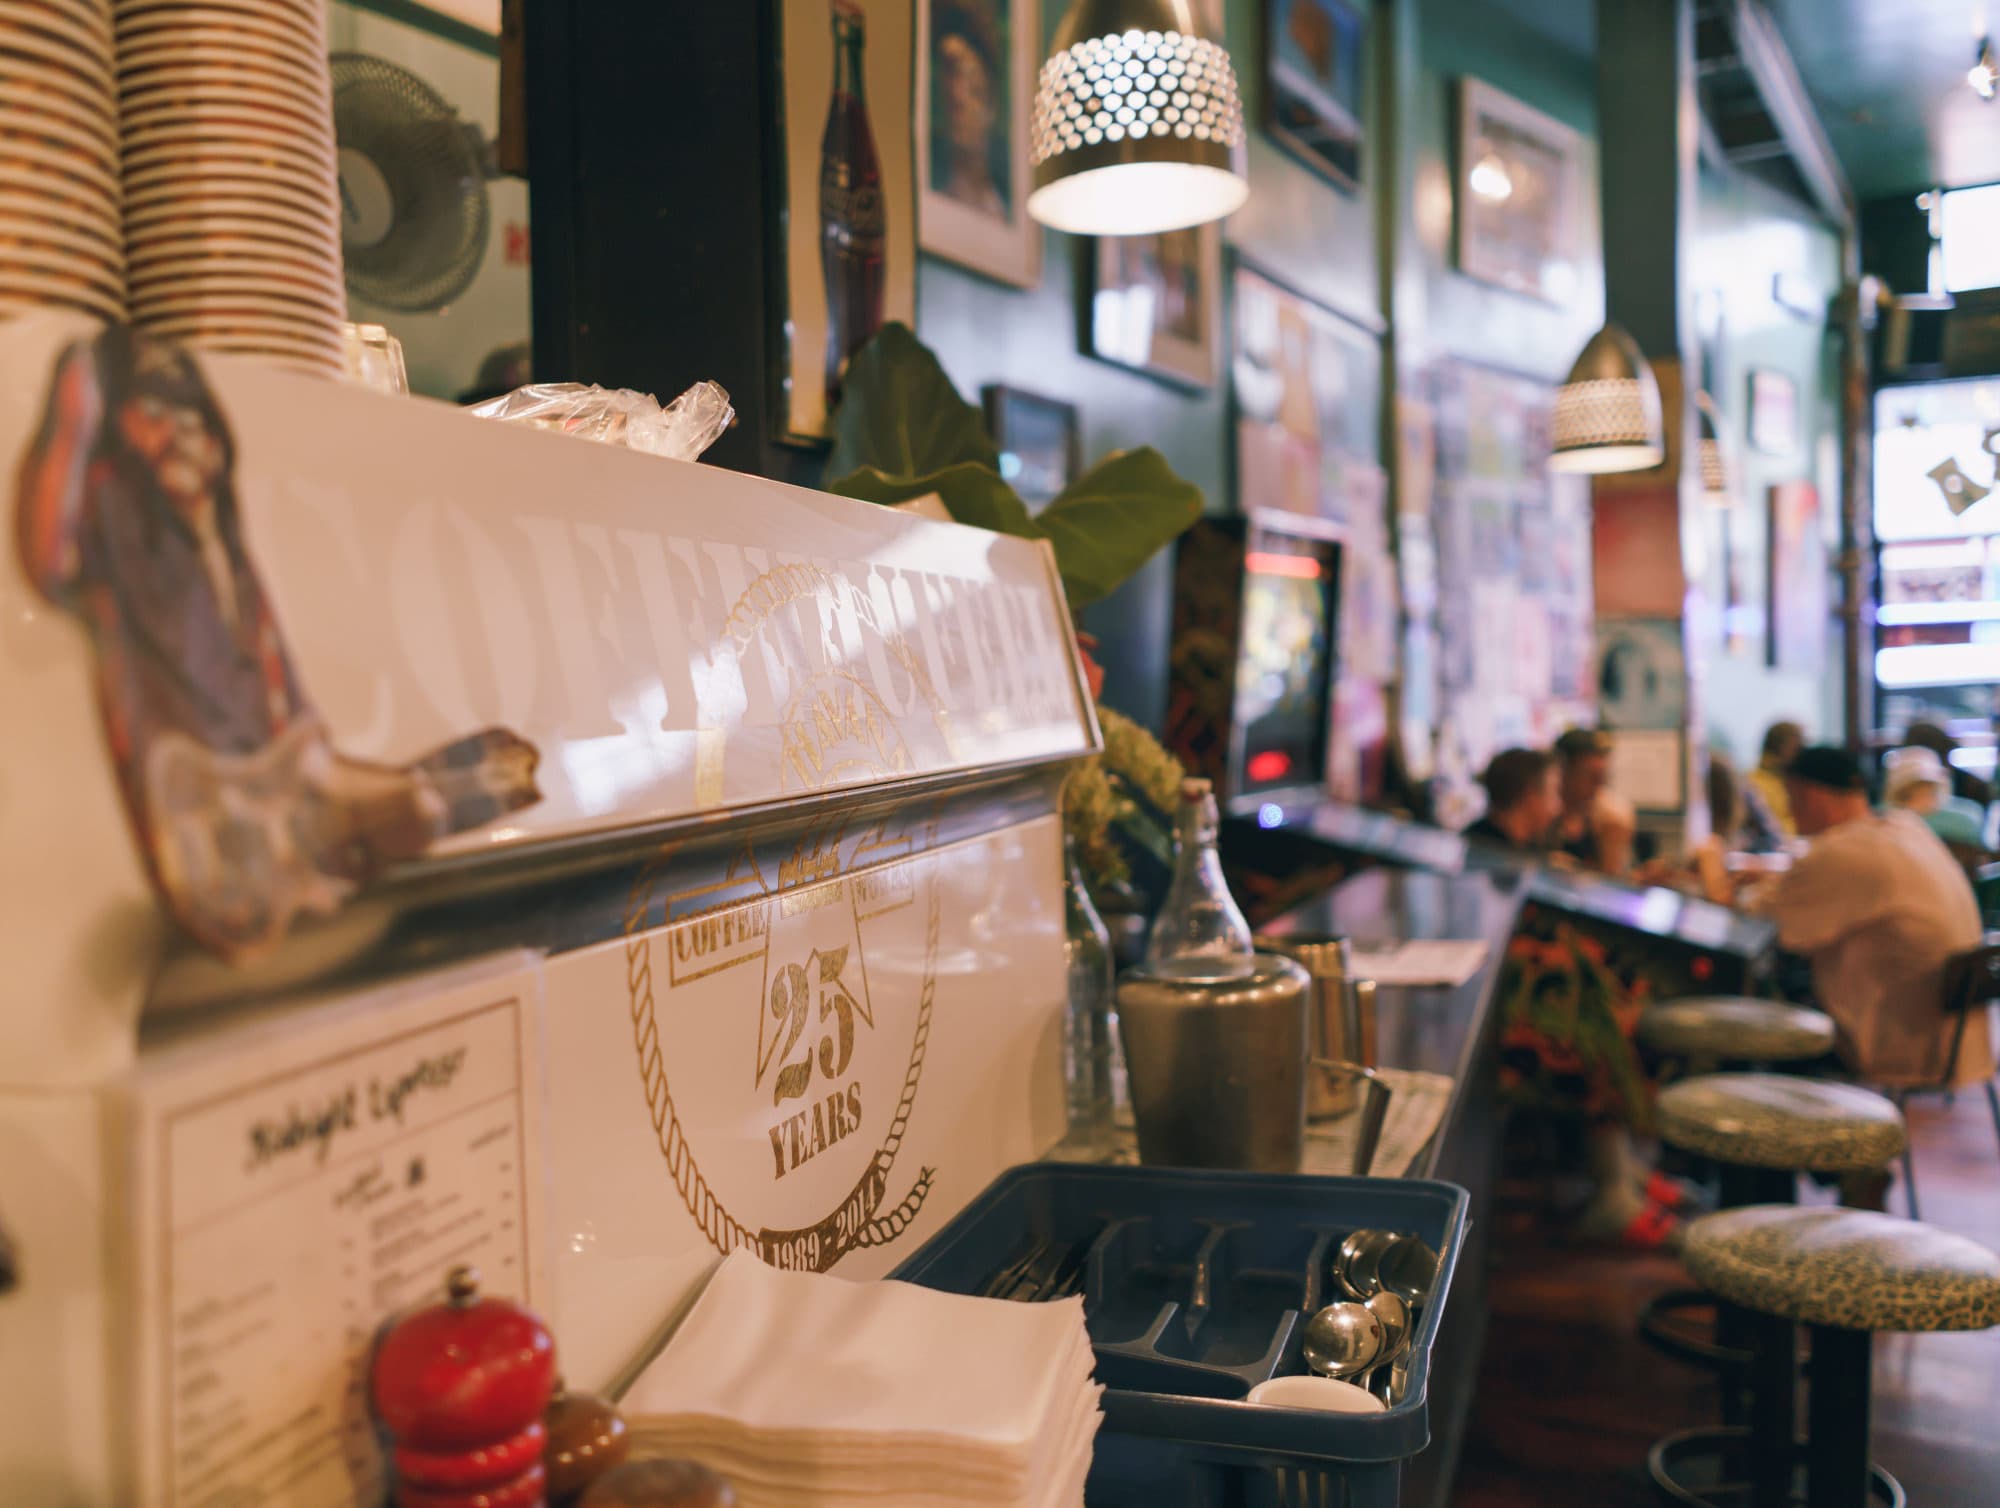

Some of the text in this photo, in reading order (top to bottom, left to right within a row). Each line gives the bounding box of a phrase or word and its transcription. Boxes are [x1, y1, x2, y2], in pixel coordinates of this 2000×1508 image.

[675, 893, 766, 962] COFFEE
[770, 944, 856, 1107] 25
[768, 1081, 862, 1180] YEARS
[772, 1231, 821, 1272] 1989
[834, 1174, 877, 1251] 2014
